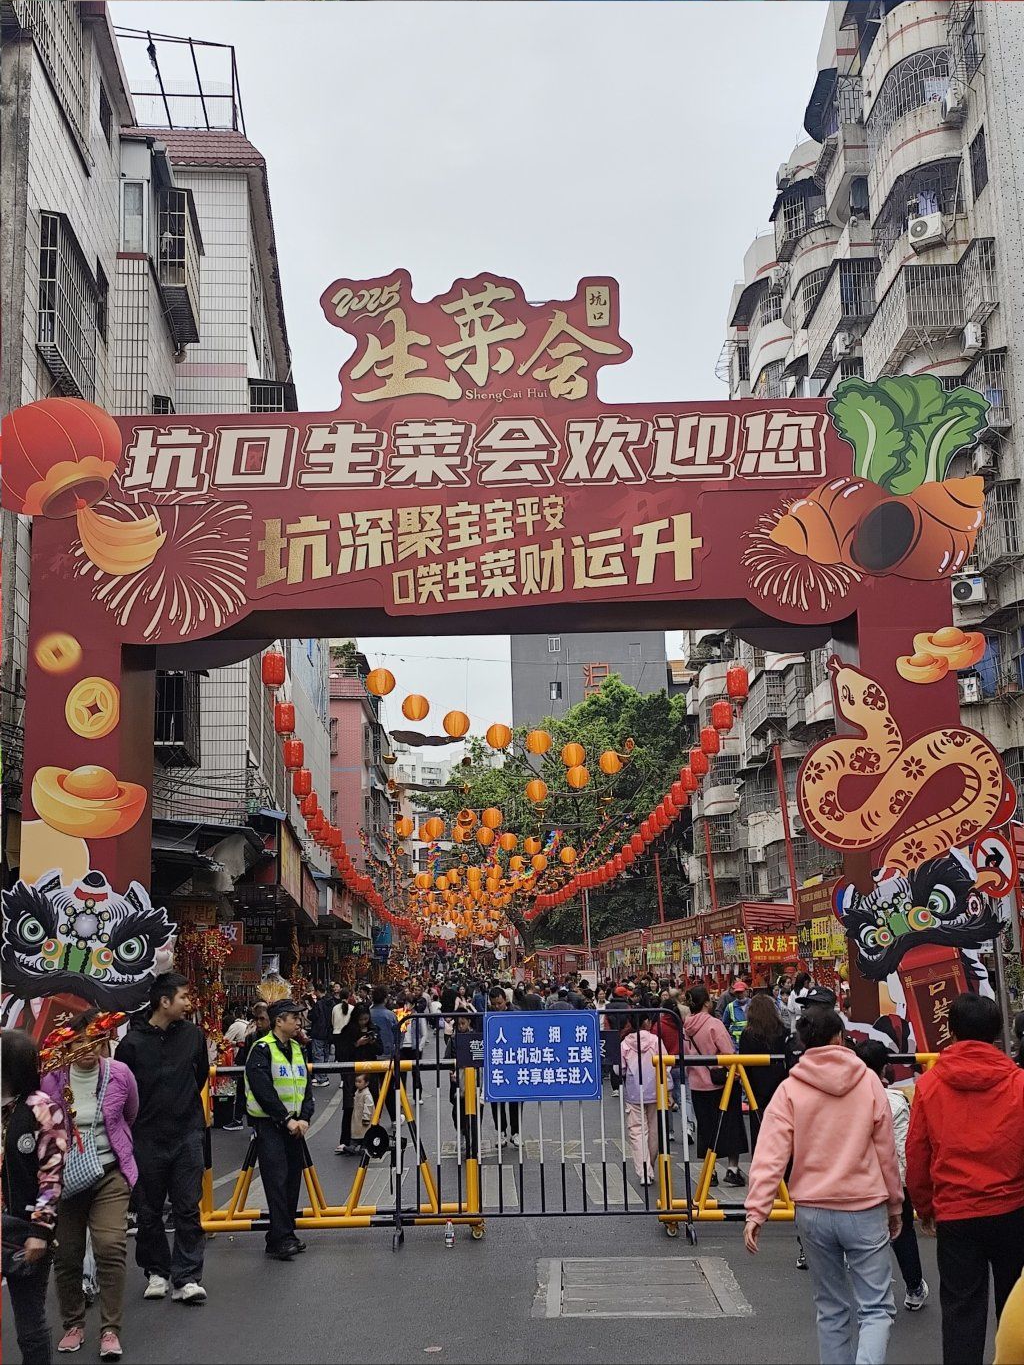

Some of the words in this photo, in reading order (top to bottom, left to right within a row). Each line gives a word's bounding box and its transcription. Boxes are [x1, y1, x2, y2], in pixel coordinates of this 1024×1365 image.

[331, 279, 401, 320] 2025
[590, 291, 607, 321] 坑口
[349, 281, 624, 402] 生菜会
[465, 389, 522, 403] ShengCai
[527, 388, 548, 399] Hui
[124, 413, 828, 492] 坑口生菜会欢迎您
[256, 494, 568, 588] 坑深聚宝宝平安
[392, 511, 703, 606] 口笑生菜财运升
[495, 1026, 588, 1044] 人流拥挤
[491, 1046, 593, 1065] 禁止机动车、五类
[491, 1068, 593, 1086] 车、共享单车进入
